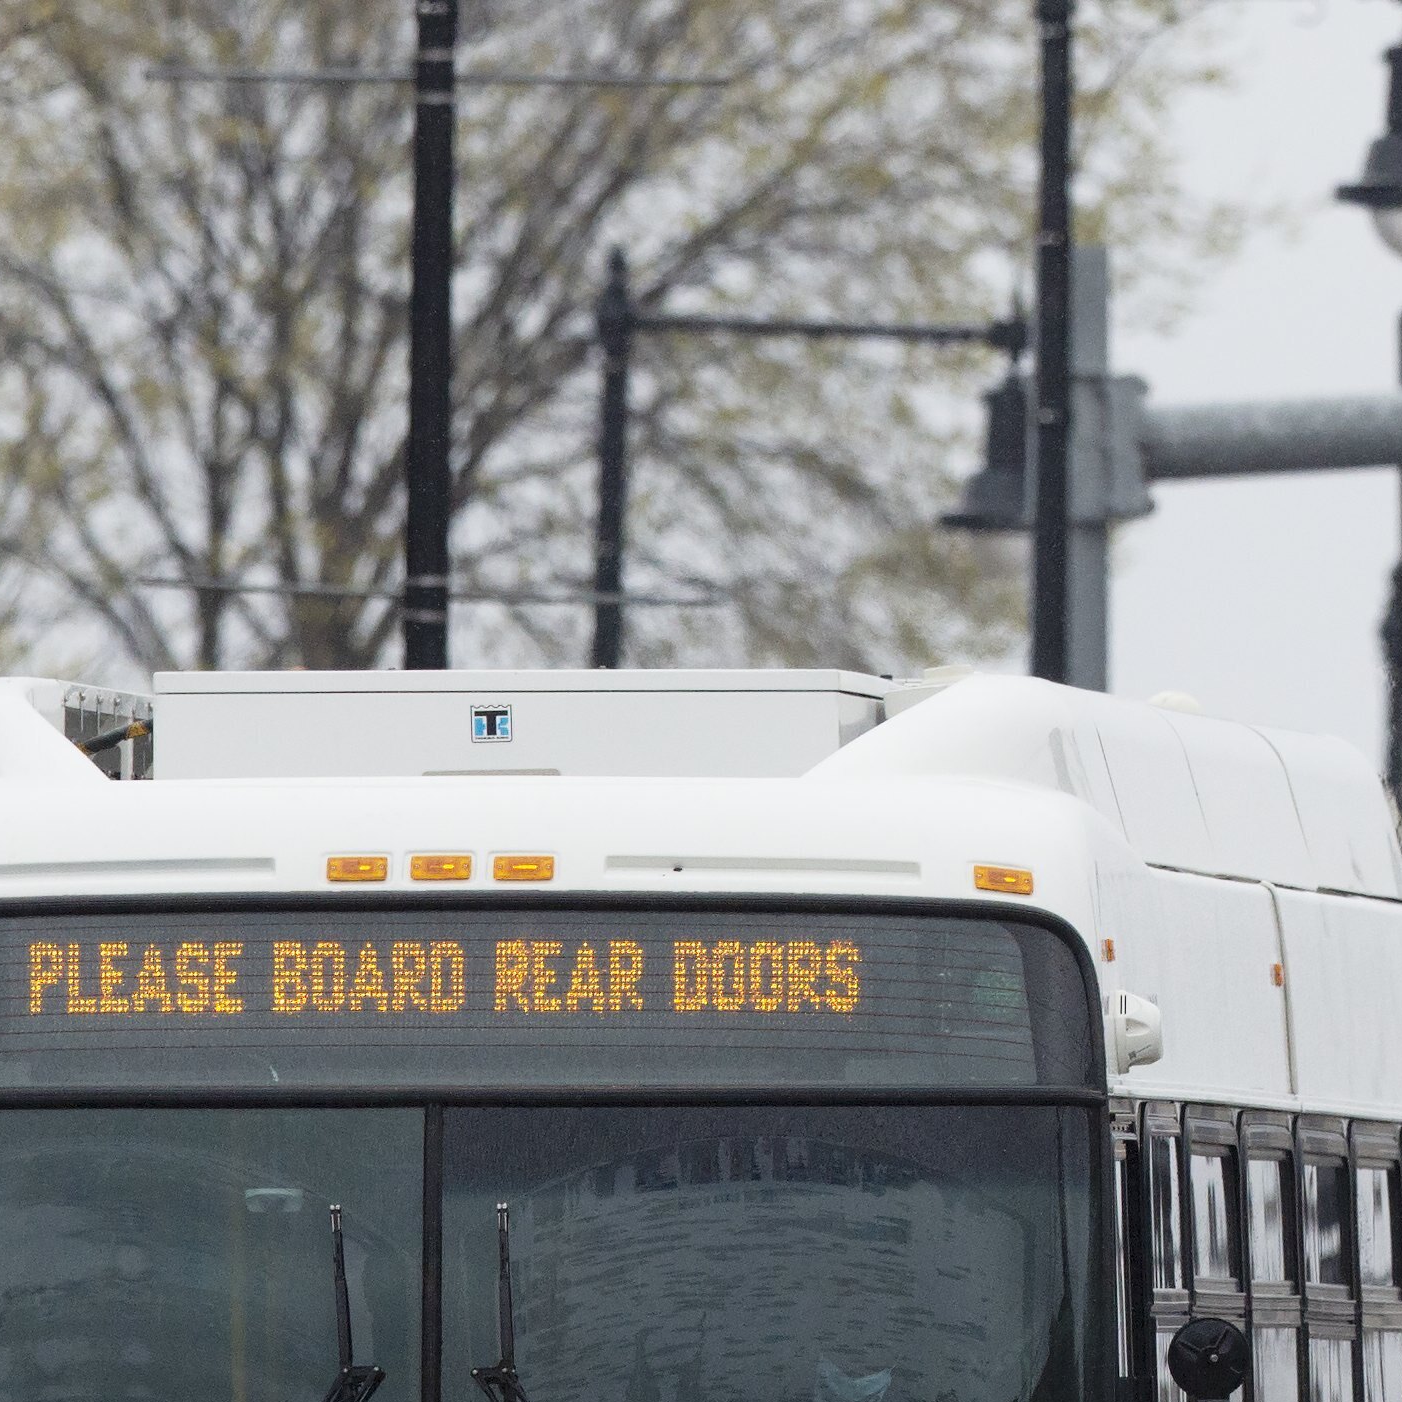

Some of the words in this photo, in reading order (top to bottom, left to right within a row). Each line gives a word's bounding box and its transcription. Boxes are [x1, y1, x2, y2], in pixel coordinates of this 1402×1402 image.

[28, 941, 244, 1014] PLEASE
[273, 940, 466, 1013] BOARD
[494, 939, 644, 1013] REAR
[673, 939, 861, 1014] DOORS
